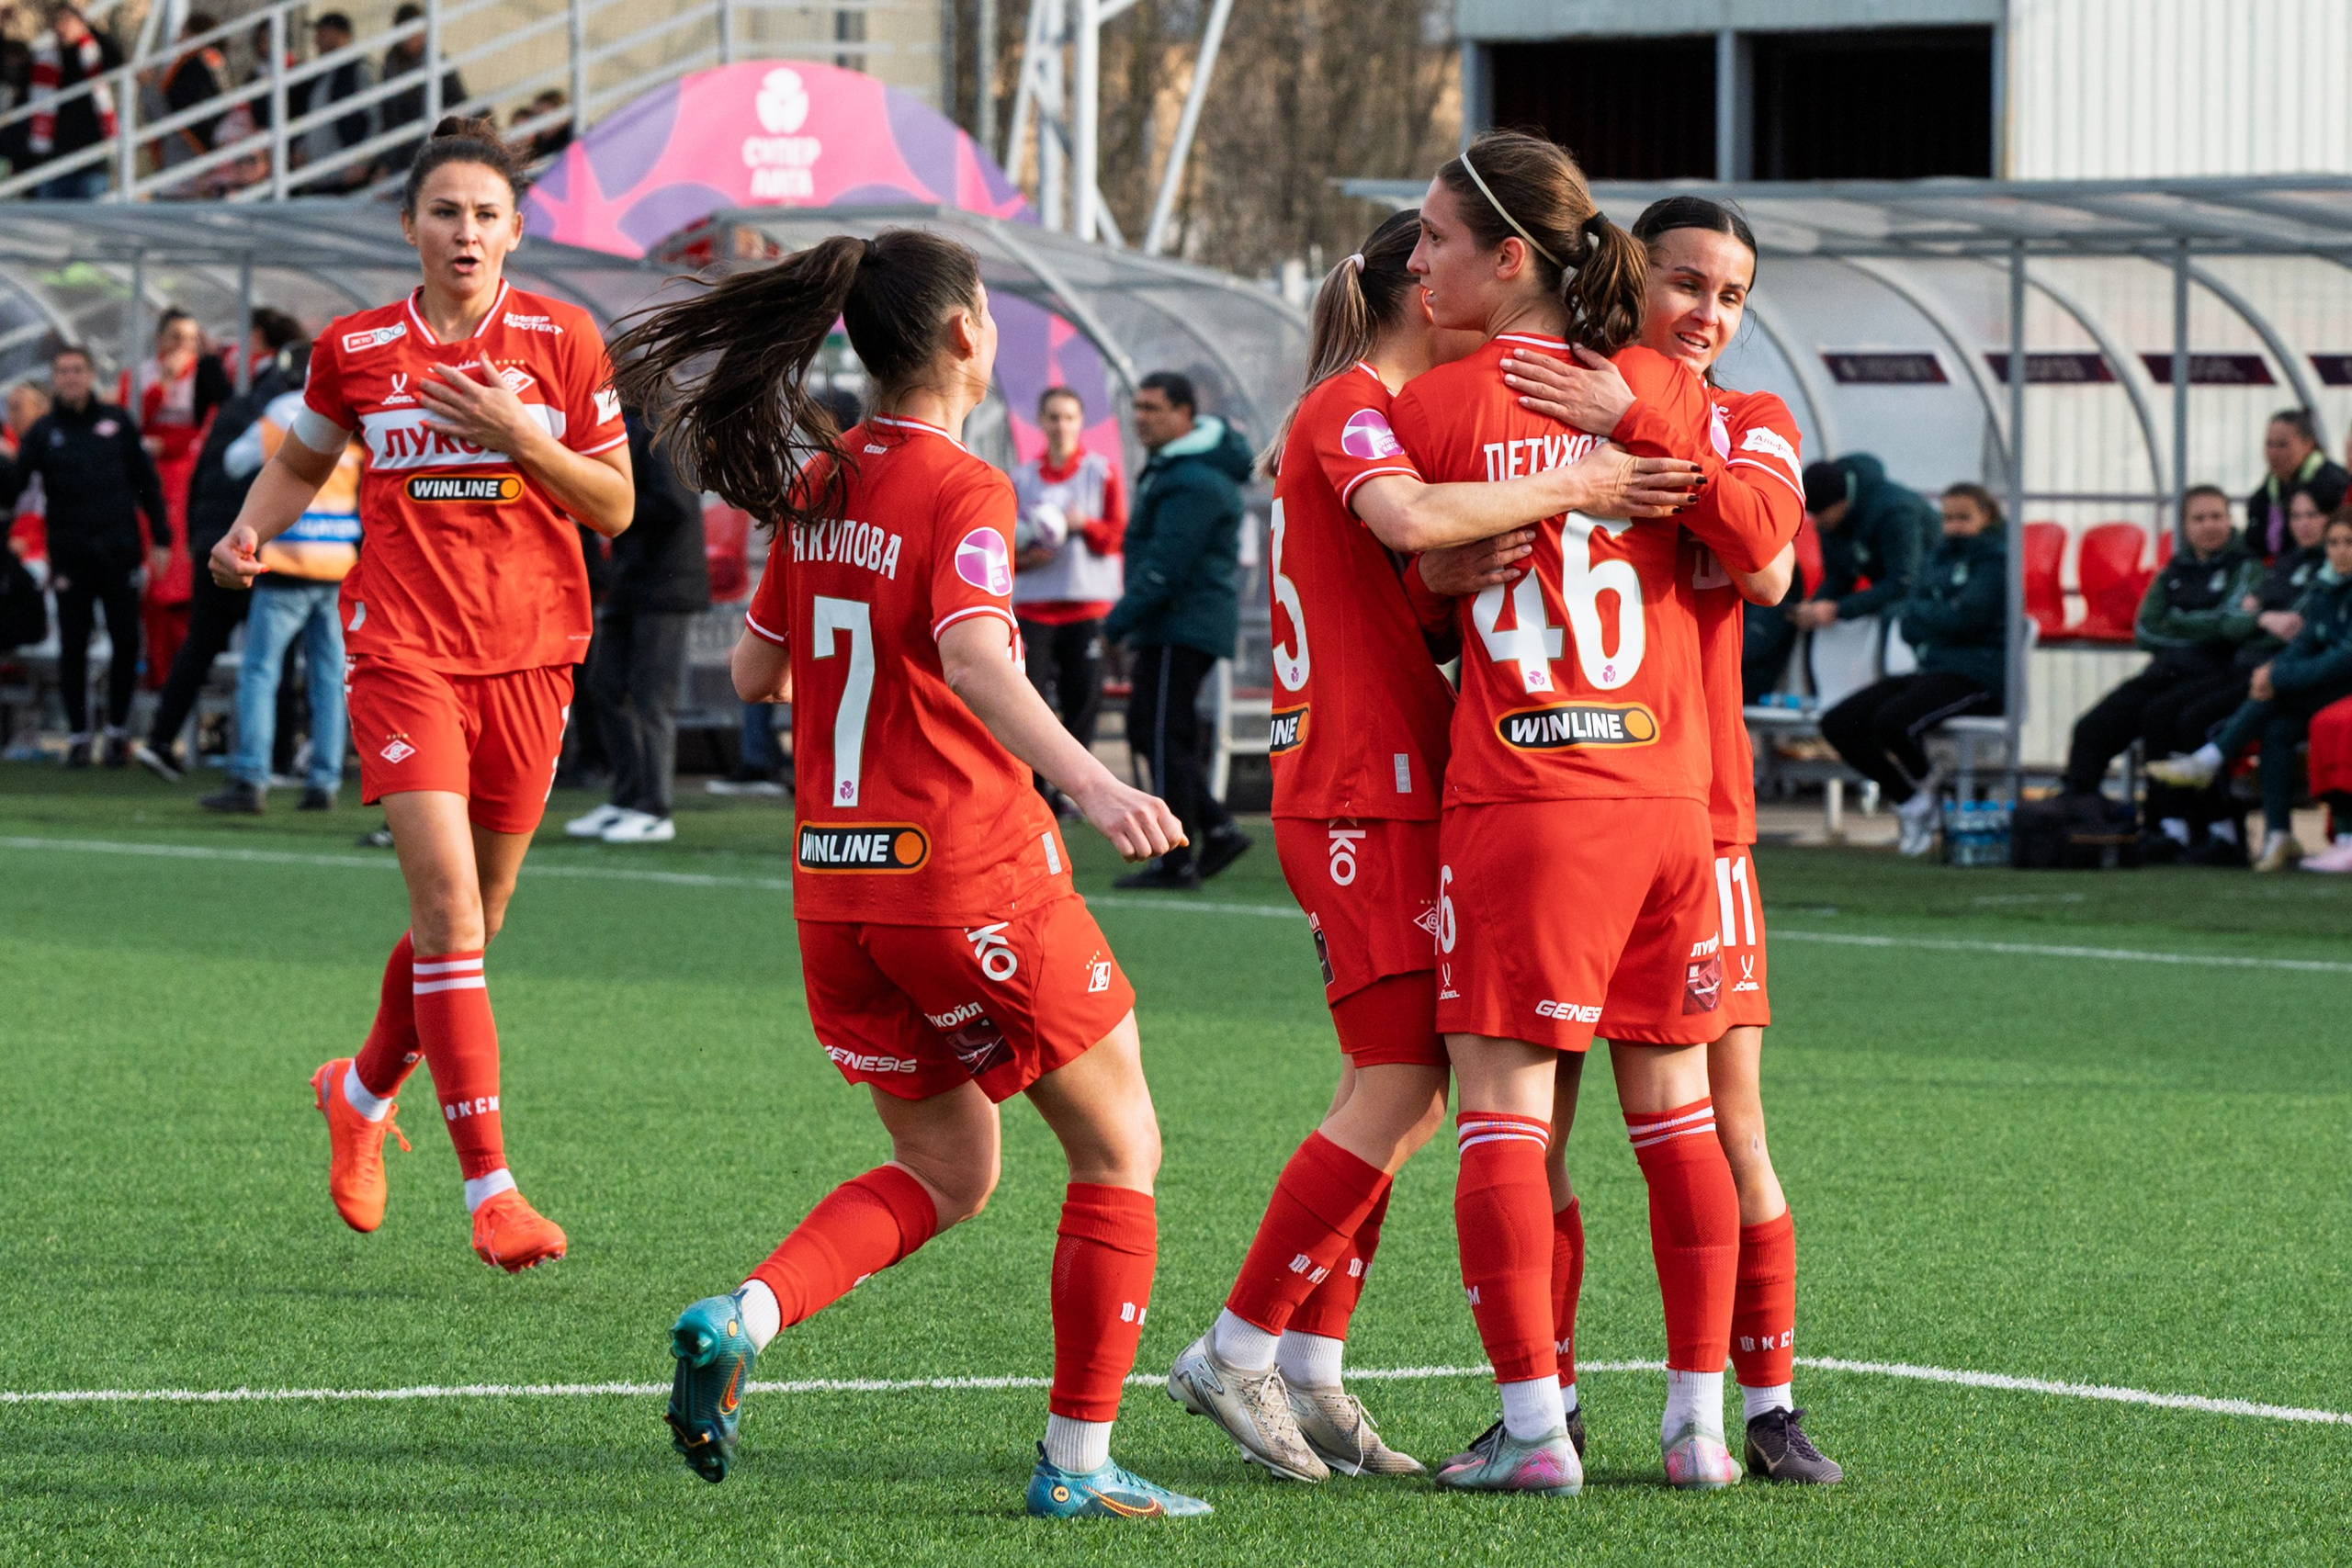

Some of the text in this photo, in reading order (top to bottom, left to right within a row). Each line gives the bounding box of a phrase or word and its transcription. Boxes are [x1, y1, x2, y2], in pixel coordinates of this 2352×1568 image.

[1483, 433, 1609, 483] ПЕТУХО
[413, 480, 499, 497] WINLINE
[1472, 509, 1646, 694] 46
[812, 594, 876, 807] 7
[1510, 712, 1624, 743] WINLINE
[1715, 856, 1756, 946] 11
[1535, 999, 1603, 1023] GENES
